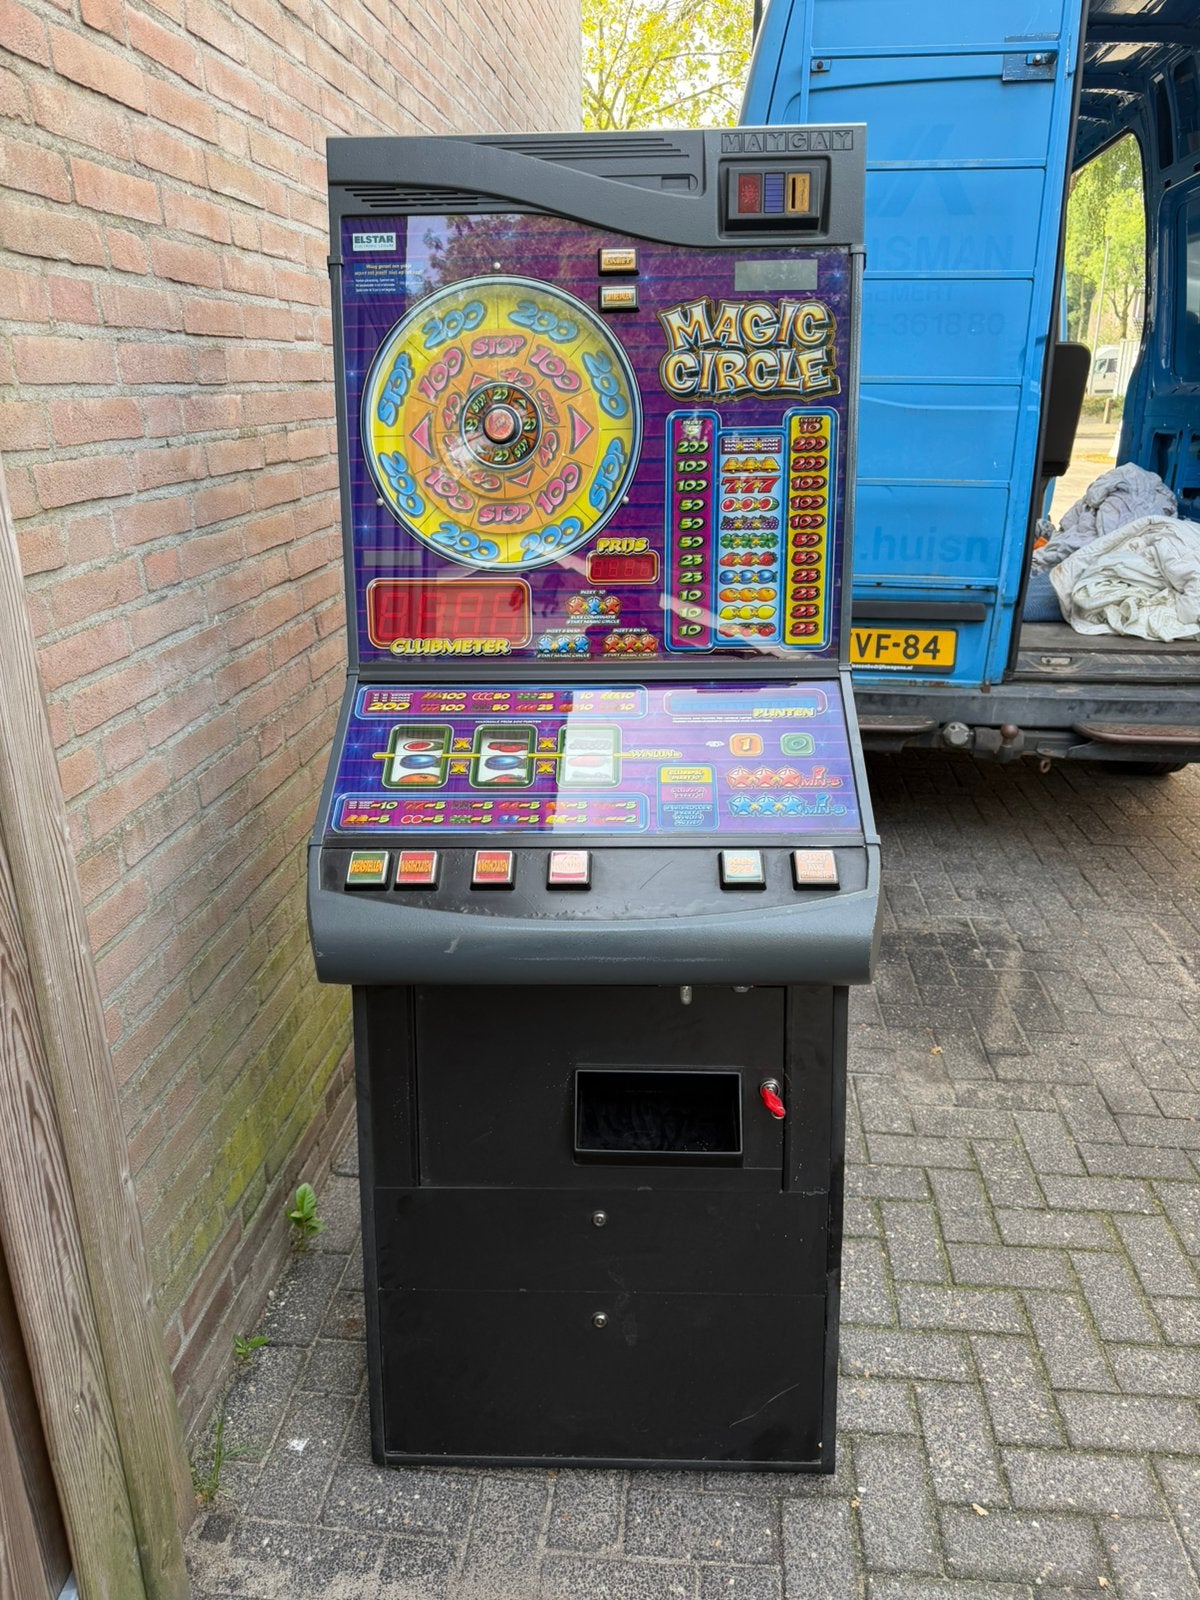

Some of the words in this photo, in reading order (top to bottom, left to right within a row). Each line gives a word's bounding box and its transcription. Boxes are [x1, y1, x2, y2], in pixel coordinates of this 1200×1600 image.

[721, 130, 853, 153] MAYGAY
[354, 235, 394, 244] ELSTAR
[422, 300, 486, 350] 200
[508, 300, 580, 343] 200
[659, 298, 831, 351] MAGIC
[470, 335, 526, 358] STOP
[418, 348, 465, 401] 100
[529, 345, 581, 394] 100
[662, 346, 834, 396] CIRCLE
[377, 351, 415, 427] STOP
[581, 350, 629, 419] 200
[800, 422, 822, 434] 10
[675, 439, 710, 454] 200
[791, 437, 828, 452] 200
[675, 460, 709, 473] 100
[792, 456, 828, 472] 200
[589, 438, 628, 513] STOP
[378, 451, 425, 517] 200
[424, 467, 476, 512] 100
[536, 463, 581, 514] 100
[675, 479, 709, 493] 100
[791, 476, 827, 491] 100
[678, 498, 705, 512] 50
[790, 495, 826, 510] 100
[478, 503, 531, 526] STOP
[790, 514, 826, 529] 100
[678, 517, 705, 531] 50
[430, 521, 500, 561] 200
[519, 516, 584, 561] 200
[597, 538, 649, 554] PRIJS
[678, 535, 704, 549] 50
[791, 533, 822, 548] 50
[791, 551, 821, 566] 50
[678, 589, 703, 602] 10
[678, 606, 703, 619] 10
[678, 624, 703, 637] 10
[390, 638, 511, 656] CLUBMETER
[851, 631, 941, 660] VF-84
[441, 692, 467, 700] 100
[493, 692, 511, 700] 50
[538, 692, 554, 700] 25
[367, 702, 411, 712] 200
[440, 703, 465, 712] 100
[492, 703, 510, 711] 50
[536, 703, 554, 711] 25
[753, 708, 816, 719] PUNTEN
